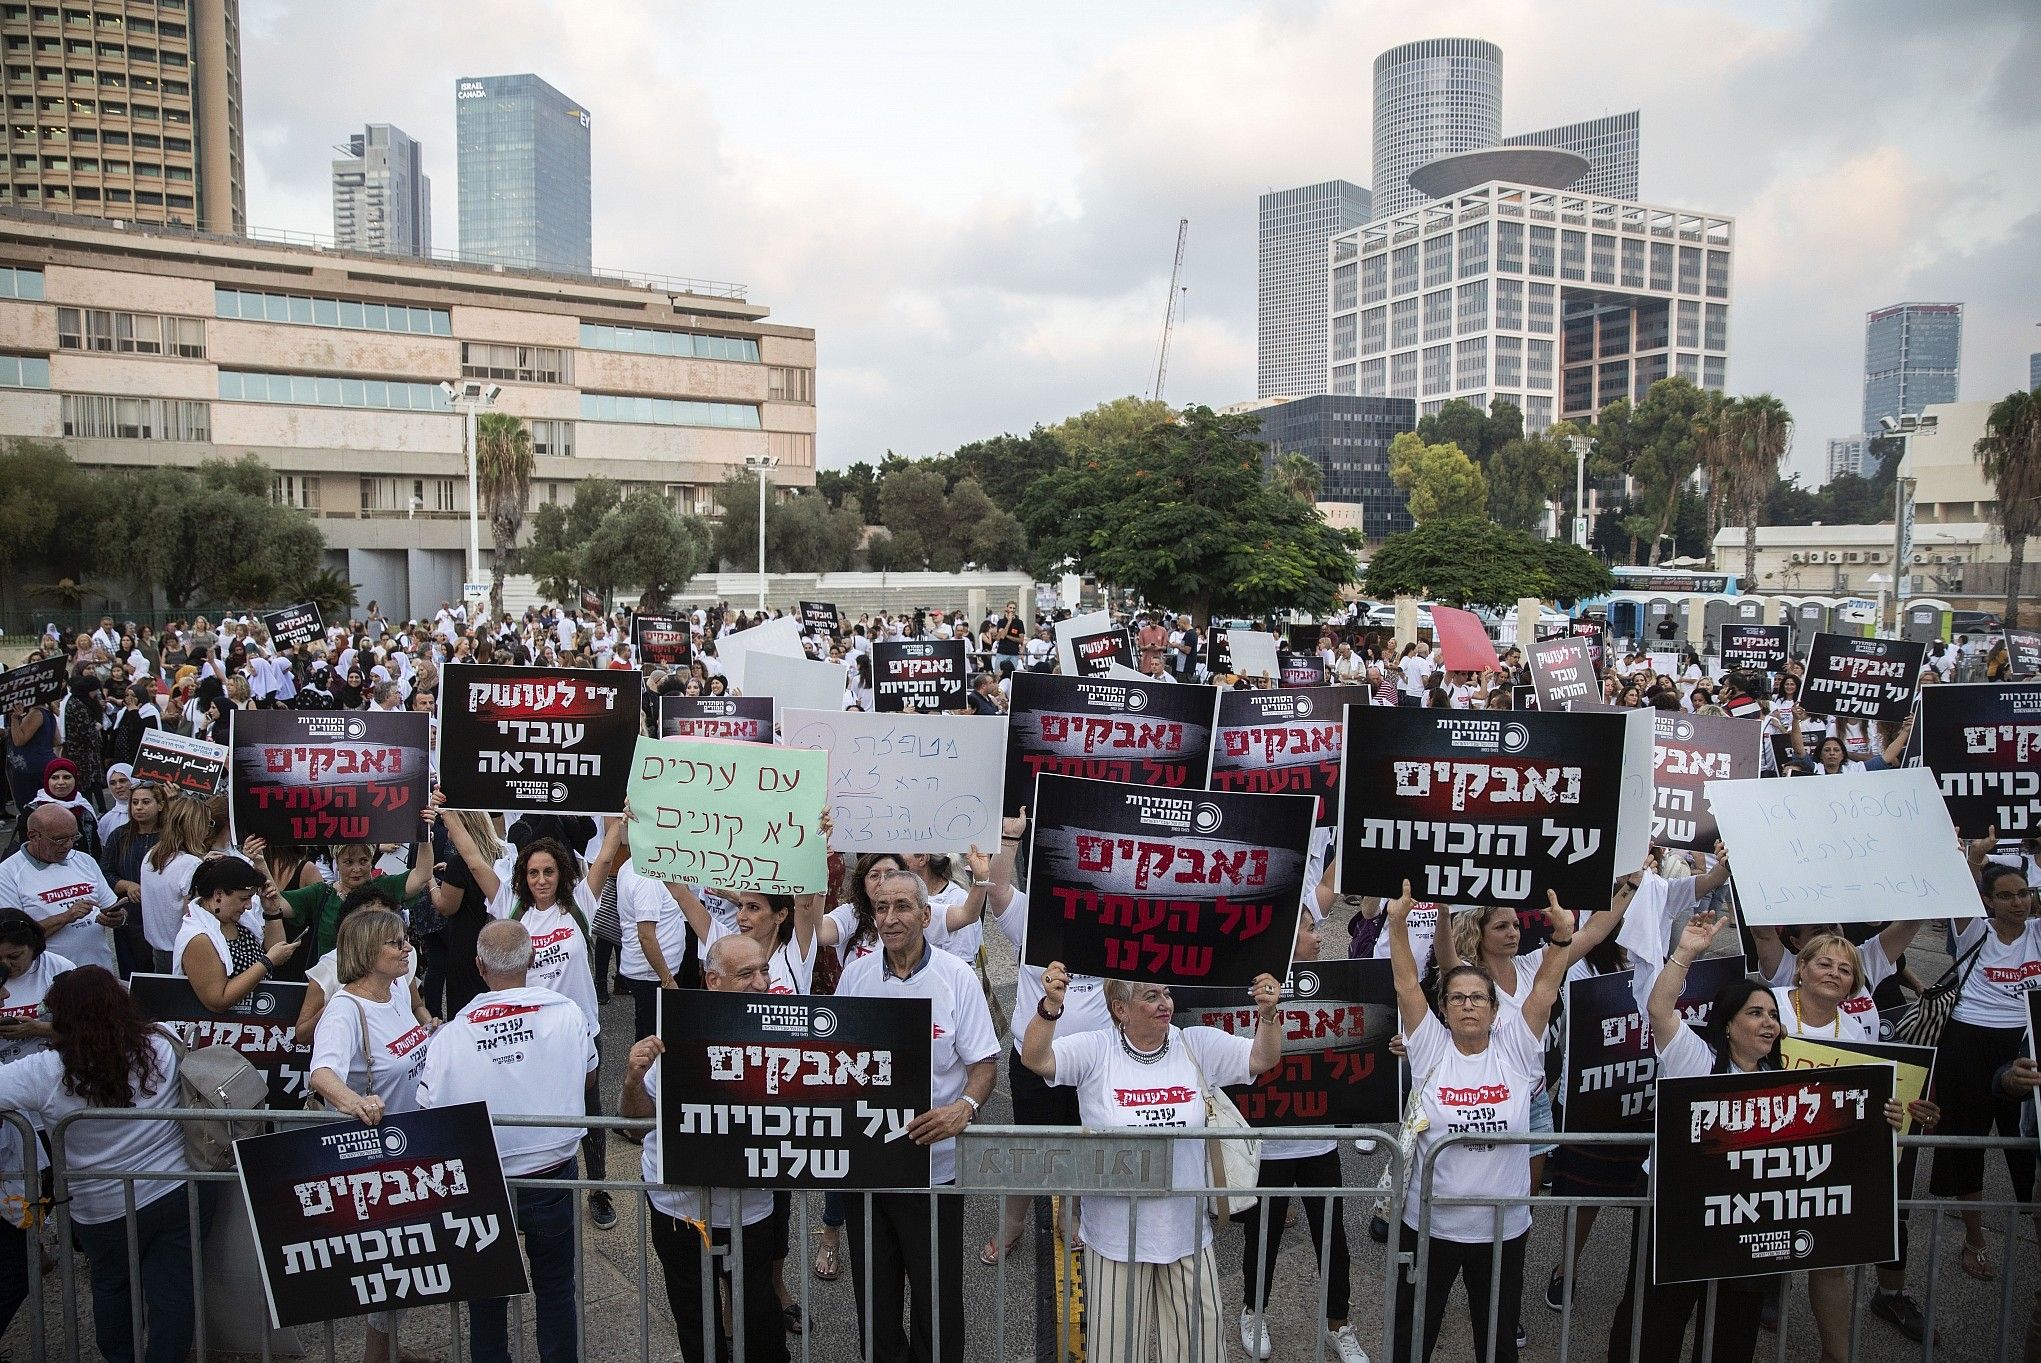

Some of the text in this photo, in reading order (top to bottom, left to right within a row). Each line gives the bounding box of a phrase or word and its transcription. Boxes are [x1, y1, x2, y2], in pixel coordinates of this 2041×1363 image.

[458, 91, 487, 99] CANADA
[460, 82, 484, 90] ISRAEL
[580, 113, 591, 128] EY
[1848, 600, 1877, 610] שירותים
[275, 614, 313, 631] נאבקים
[274, 623, 320, 642] על הזכויות
[1732, 636, 1779, 648] נאבקים
[1111, 637, 1122, 649] די
[1536, 644, 1581, 670] די לעושק
[1725, 649, 1785, 660] על הזכויות
[1741, 659, 1768, 669] שלנו
[888, 659, 953, 678] נאבקים
[1550, 667, 1578, 682] עובדי
[1829, 655, 1905, 678] נאבקים
[40, 682, 58, 692] על
[469, 678, 618, 713] די לעושק
[880, 677, 961, 695] על הזכויות
[1077, 684, 1126, 695] הסתדרות
[1549, 682, 1588, 701] ההוראה
[1811, 678, 1909, 702] על הזכויות
[1088, 693, 1125, 702] המורים
[1250, 696, 1293, 705] הסתדרות
[2000, 692, 2041, 701] תדרות
[1262, 703, 1294, 711] המורים
[1835, 697, 1880, 716] שלנו
[298, 717, 345, 725] הסתדרות
[309, 724, 345, 732] המורים
[679, 720, 758, 737] נאבקים
[1437, 720, 1500, 731] הסתדרות
[497, 720, 585, 749] עובדי
[853, 726, 958, 759] מטפלת
[1040, 715, 1183, 753] נאבקים
[1451, 730, 1500, 741] המורים
[1964, 725, 2041, 763] קים
[264, 748, 402, 781] נאבקים
[478, 751, 601, 776] ההוראה
[1142, 756, 1188, 788] על
[1653, 746, 1731, 779] נאבק
[505, 780, 549, 788] הסתדרות
[642, 756, 801, 793] עם ערכים
[834, 765, 939, 791] היא לא
[1213, 766, 1311, 792] העתיד
[1939, 771, 2041, 796] כויות
[516, 787, 549, 795] המורים
[1393, 761, 1582, 811] נאבקים
[250, 781, 410, 812] על העתיד
[1126, 795, 1193, 810] הסתדרות
[1828, 788, 1920, 824] מטפלת
[1141, 807, 1192, 820] המורים
[291, 811, 370, 839] שלנו
[656, 806, 805, 850] לא קונים
[1651, 810, 1696, 843] של
[1360, 818, 1601, 865] על הזכויות
[648, 841, 787, 881] במכולת
[1076, 835, 1269, 889] נאבקים
[1424, 859, 1532, 900] שלנו
[772, 884, 805, 895] סניף
[1052, 887, 1274, 941] על העתיד
[536, 944, 561, 958] עובד
[1104, 935, 1214, 977] שלנו
[747, 1004, 808, 1015] הסתדרות
[483, 1018, 523, 1034] עובדי
[762, 1015, 808, 1025] המורים
[477, 1030, 534, 1051] ההוראה
[707, 1046, 892, 1094] נאבקים
[1322, 1047, 1375, 1084] על
[1579, 1057, 1656, 1093] כויות
[1171, 1090, 1186, 1100] די
[1489, 1087, 1505, 1098] די
[1235, 1086, 1328, 1119] שלנו
[1135, 1108, 1176, 1121] עובדי
[1457, 1107, 1496, 1120] עובדי
[1690, 1082, 1868, 1143] די לעושק
[680, 1101, 915, 1144] על הזכויות
[1448, 1120, 1508, 1133] ההוראה
[320, 1128, 379, 1146] הסתדרות
[337, 1138, 380, 1153] המורים
[744, 1141, 850, 1178] שלנו
[1727, 1144, 1832, 1181] עובדי
[294, 1159, 469, 1220] נאבקים
[1705, 1185, 1851, 1227] ההוראה
[281, 1211, 500, 1275] על הזכויות
[1739, 1231, 1790, 1244] הסתדרות
[1752, 1240, 1790, 1252] המורים
[351, 1263, 451, 1305] שלנו
